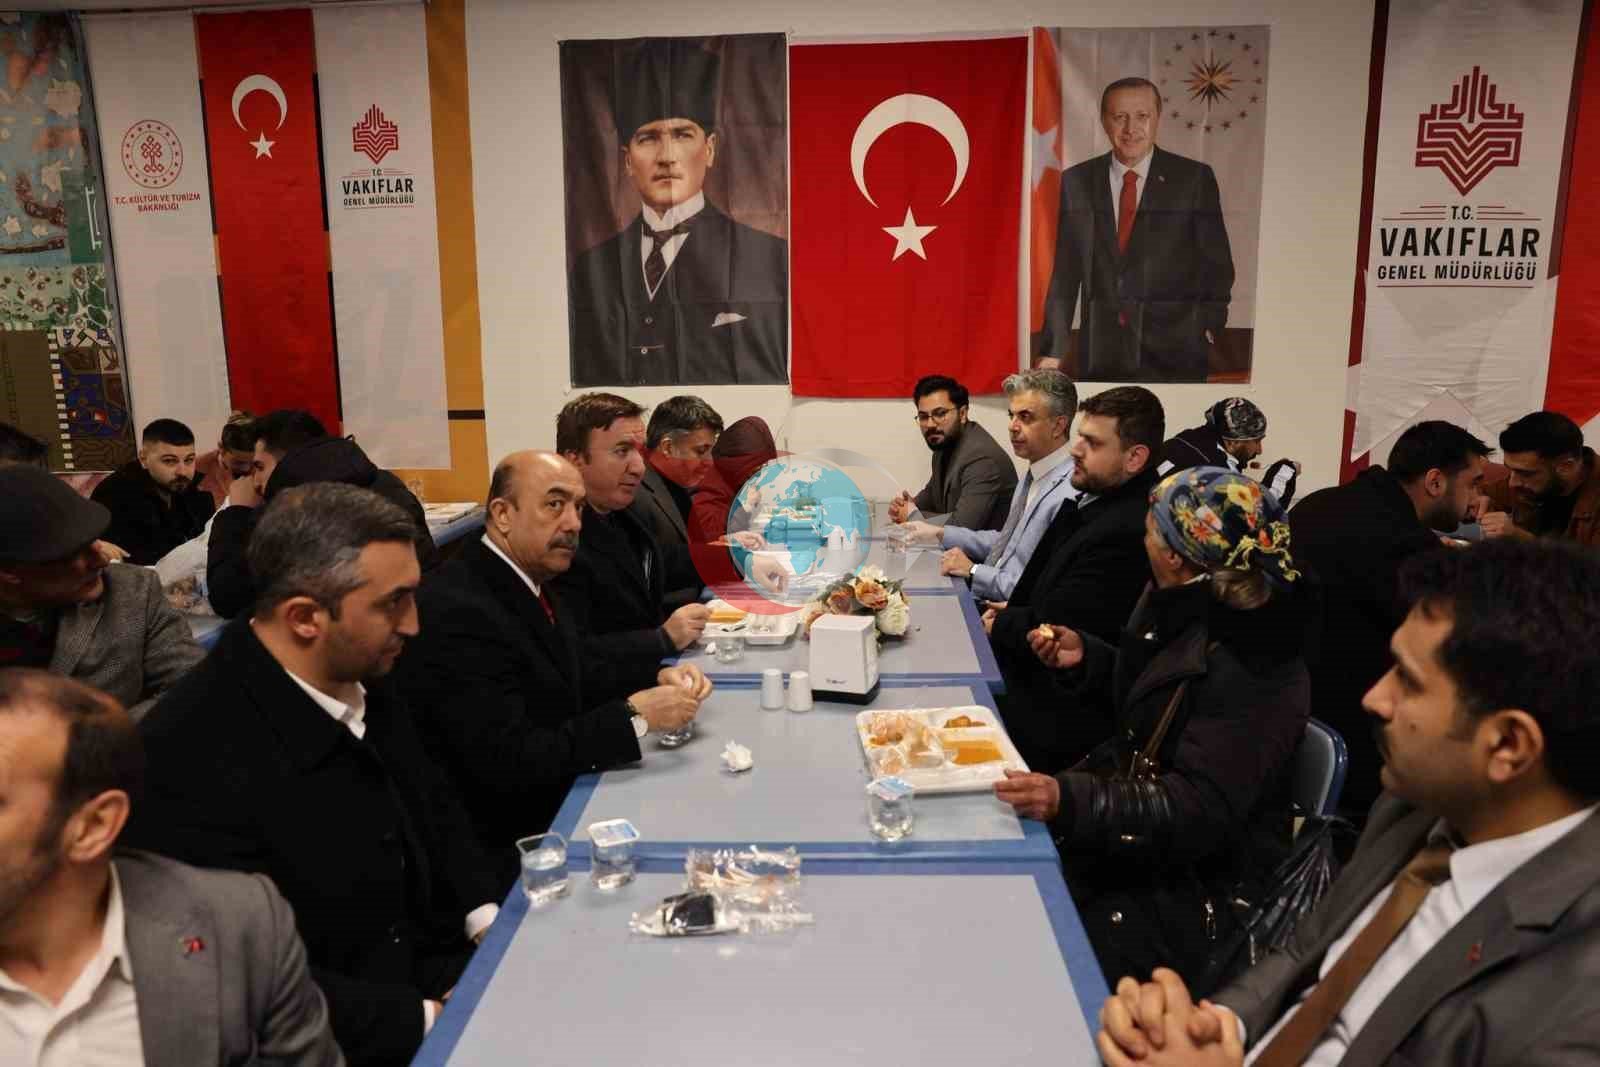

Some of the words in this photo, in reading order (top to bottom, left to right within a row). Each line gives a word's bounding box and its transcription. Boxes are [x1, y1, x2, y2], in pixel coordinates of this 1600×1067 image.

[342, 178, 414, 195] VAKIFLAR
[129, 193, 159, 203] KÜLTÜR
[160, 194, 169, 202] VE
[172, 192, 201, 202] TURİZM
[343, 198, 366, 206] GENEL
[368, 194, 414, 204] MÜDÜRLÜĞÜ
[138, 202, 179, 212] BAKANLIĞI
[1451, 205, 1474, 220] T.C.
[1380, 227, 1540, 257] VAKIFLAR
[1377, 264, 1426, 280] GENEL
[1434, 261, 1537, 281] MÜDÜRLÜĞÜ
